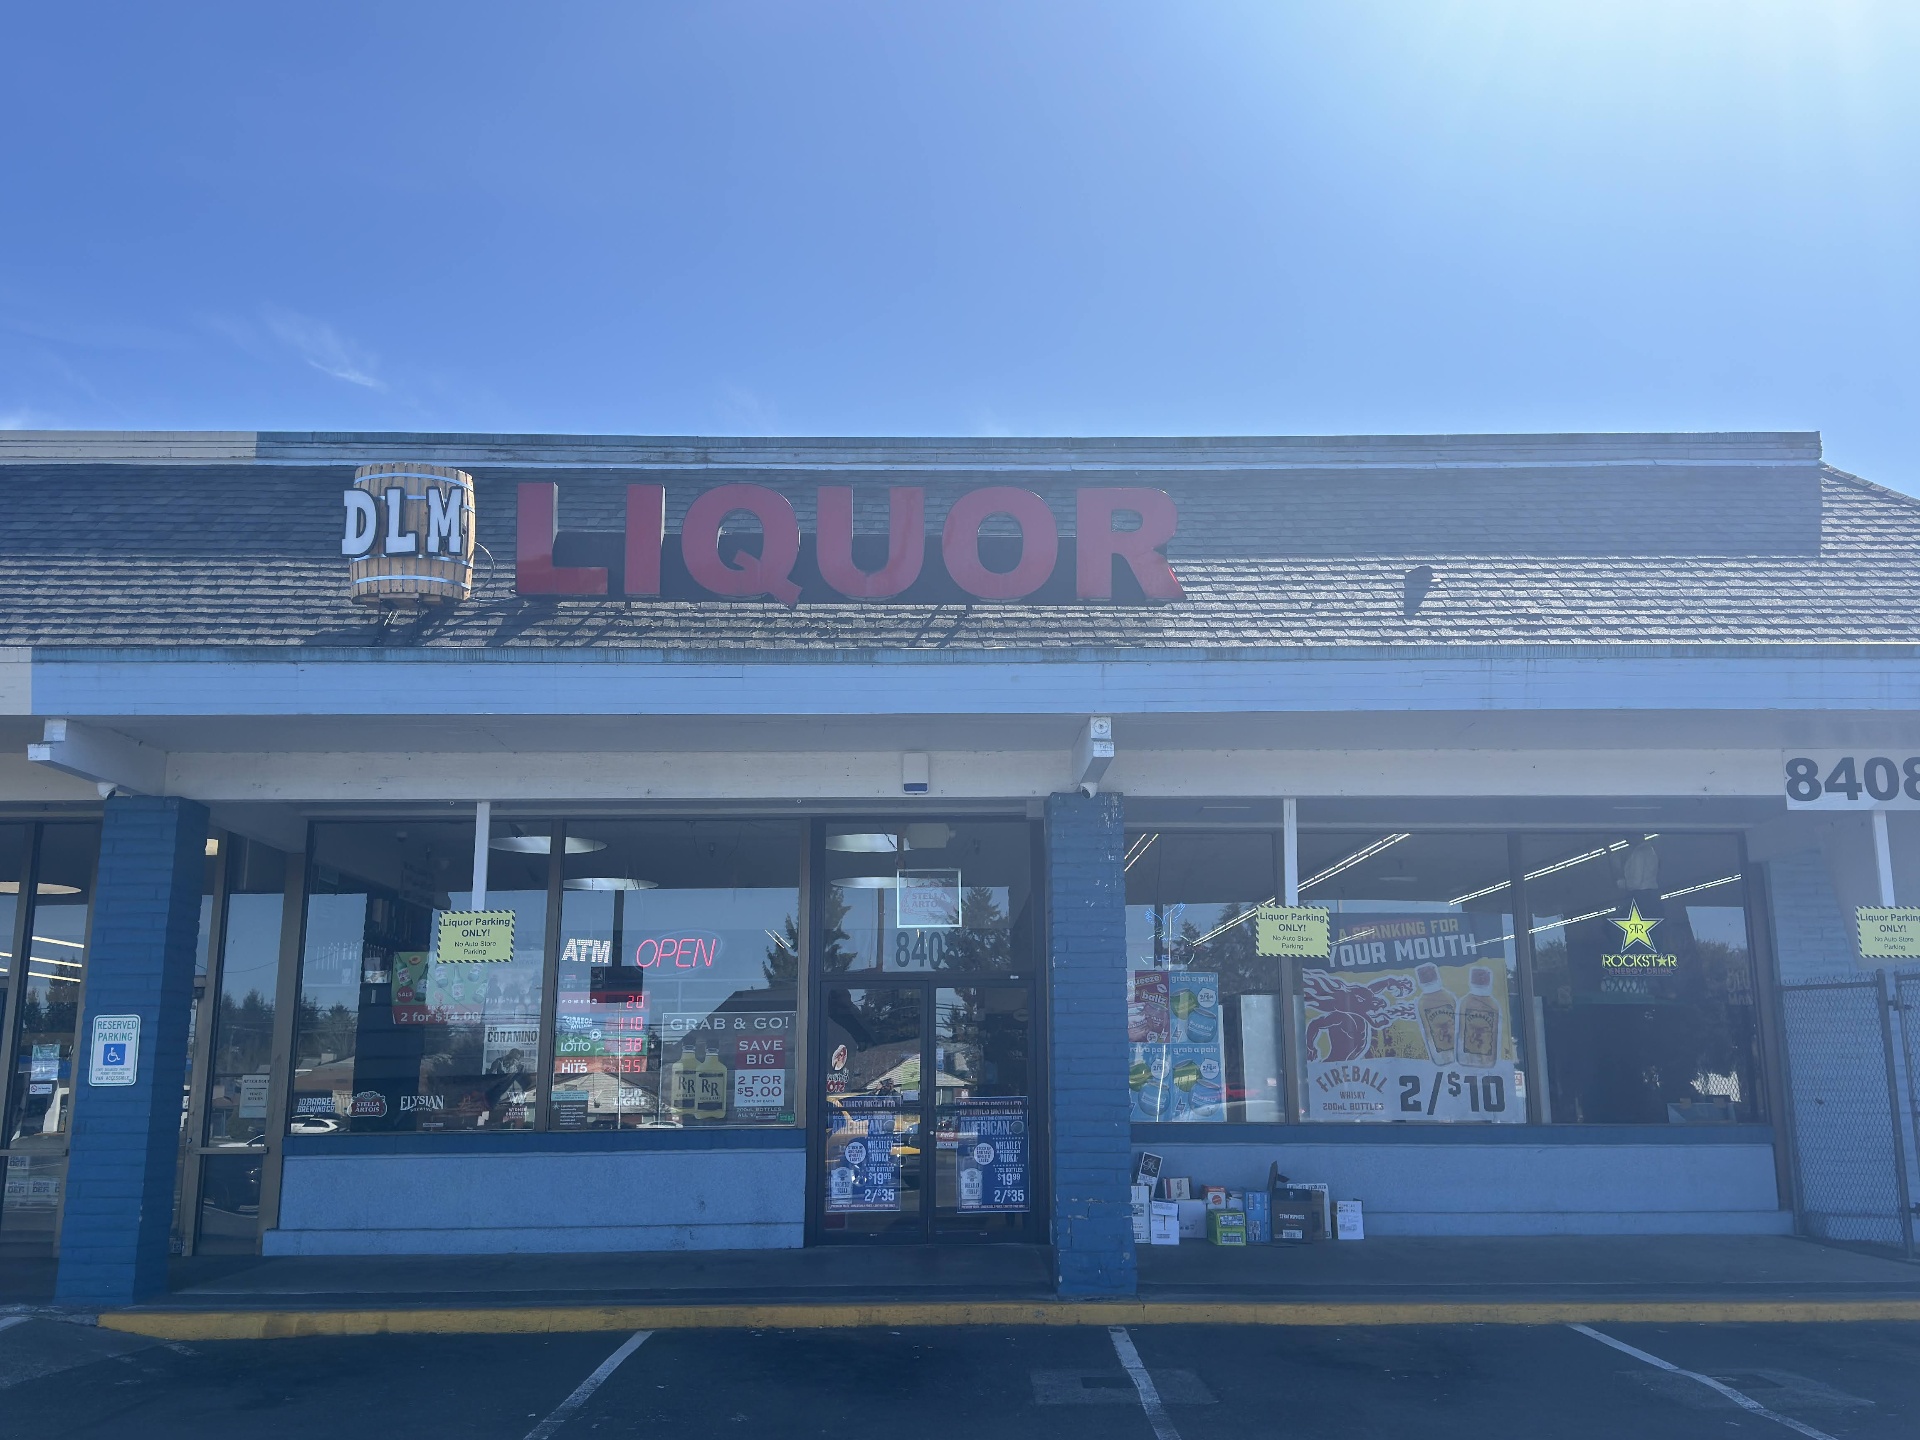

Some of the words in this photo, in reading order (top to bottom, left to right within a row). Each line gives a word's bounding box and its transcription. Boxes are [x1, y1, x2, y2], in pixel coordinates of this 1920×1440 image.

[341, 486, 464, 557] DLM
[515, 481, 1188, 609] LIQUOR
[443, 917, 473, 928] Liquor
[475, 917, 511, 927] Parking
[1259, 912, 1288, 922] Liquor
[1291, 912, 1325, 924] Parking
[1860, 913, 1889, 923] Liquor
[1890, 913, 1920, 922] Parkin
[1278, 923, 1306, 932] ONLY!
[1338, 928, 1347, 940] A
[1430, 918, 1459, 933] FOR
[1879, 924, 1907, 933] ONLY!
[461, 929, 490, 938] ONLY!
[463, 948, 487, 956] Parking
[561, 938, 611, 963] ATM
[1281, 942, 1304, 951] Parking
[1330, 941, 1387, 968] YOUR
[1394, 933, 1477, 962] MOUTH
[1883, 943, 1906, 952] Parking
[636, 938, 717, 968] OPEN
[1171, 974, 1191, 984] grab
[625, 995, 645, 1009] 20
[400, 1013, 408, 1022] 2
[412, 1012, 433, 1022] for
[97, 1020, 137, 1030] RESERVED
[670, 1018, 726, 1031] GRAB
[733, 1018, 746, 1030] &
[754, 1016, 789, 1030] GO!
[98, 1032, 133, 1042] PARKING
[487, 1030, 538, 1043] CORAMINO
[560, 1042, 591, 1052] LOTTO
[624, 1037, 642, 1053] 38
[738, 1040, 783, 1051] SAVE
[1173, 1045, 1193, 1055] grab
[1200, 1045, 1217, 1055] pair
[746, 1053, 775, 1065] BIG
[561, 1062, 588, 1073] HIT5
[624, 1059, 641, 1073] 35
[737, 1075, 746, 1085] 2
[751, 1075, 782, 1085] FOR
[1315, 1065, 1388, 1094] FIREBALL
[619, 1087, 643, 1097] BUD
[737, 1086, 782, 1098] $5.00
[1339, 1091, 1366, 1099] WHISKY
[1398, 1071, 1506, 1116] 2/$10
[305, 1097, 336, 1107] BARREL
[400, 1094, 444, 1111] ELYSIAN
[1349, 1102, 1385, 1111] BOTTLES
[960, 1121, 1012, 1136] AMERICAN.
[867, 1140, 893, 1149] WHEATLEY
[995, 1141, 1021, 1150] WHEATLEY
[864, 1188, 895, 1203] 2/$35
[994, 1189, 1025, 1204] 2/$35
